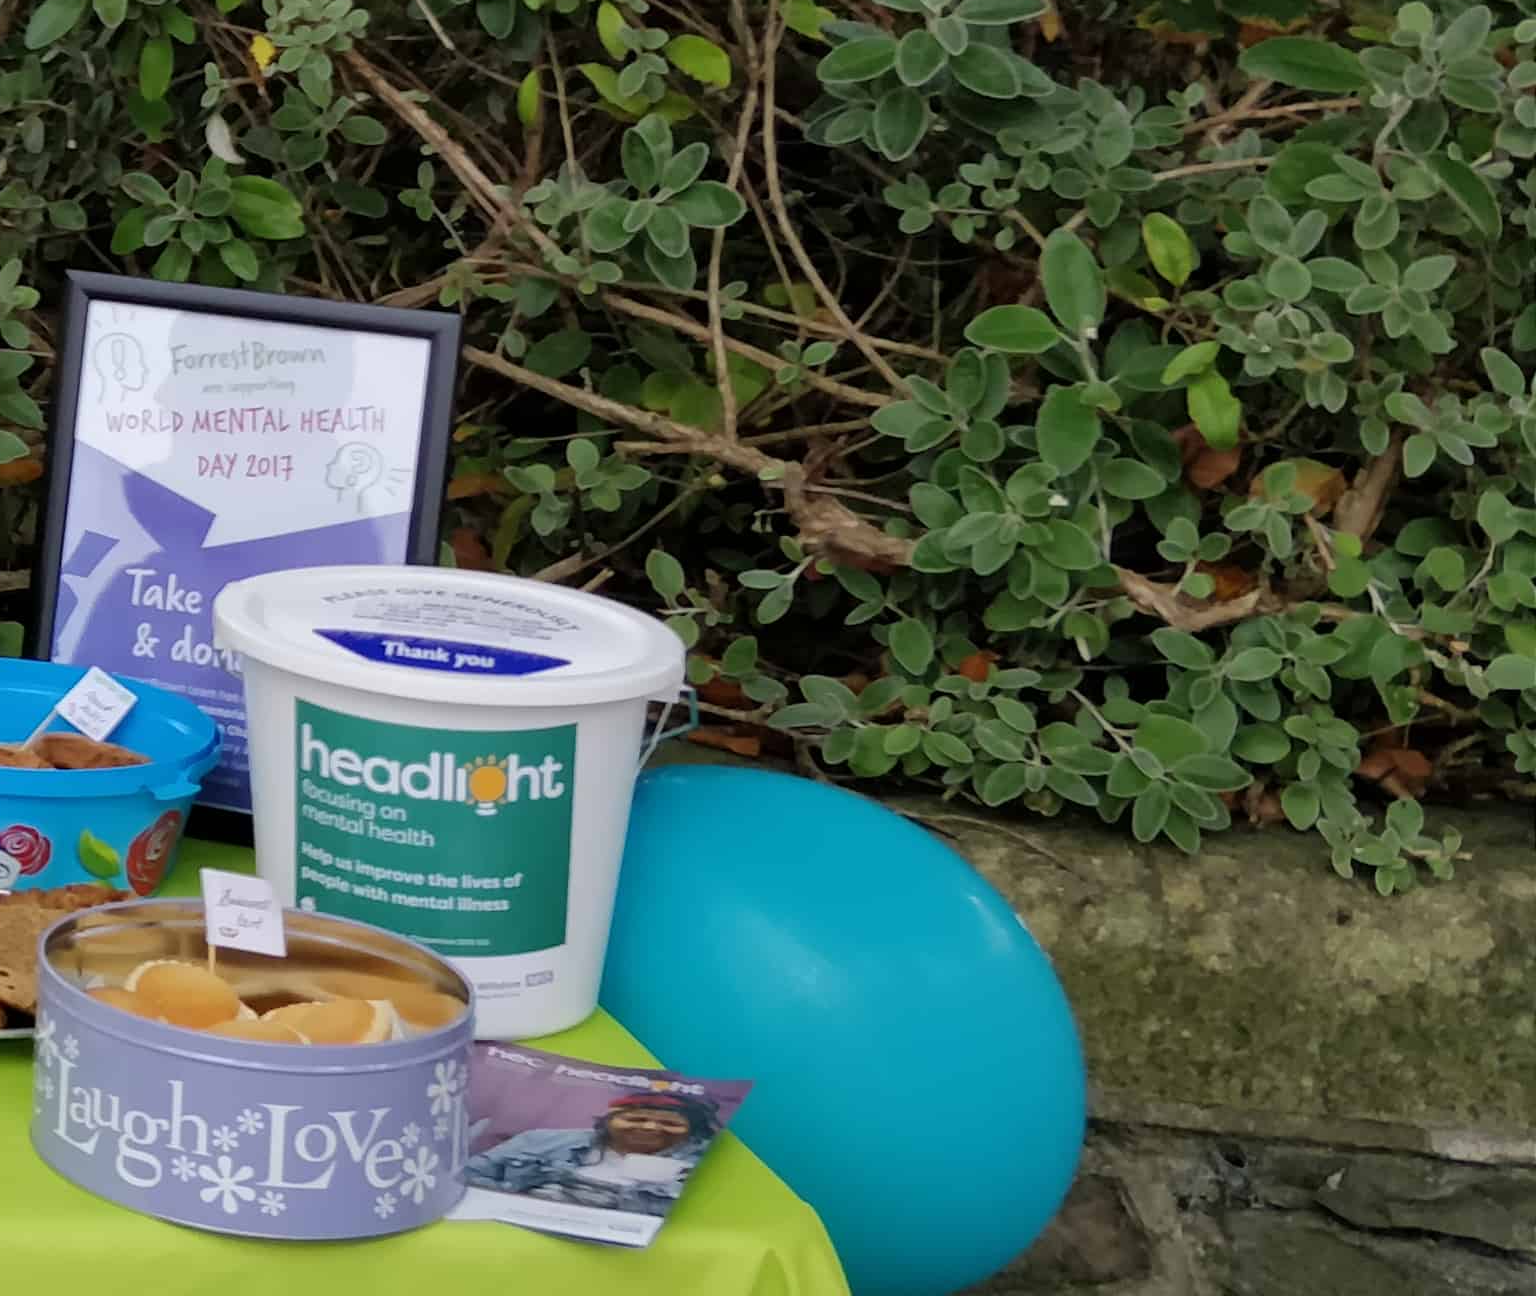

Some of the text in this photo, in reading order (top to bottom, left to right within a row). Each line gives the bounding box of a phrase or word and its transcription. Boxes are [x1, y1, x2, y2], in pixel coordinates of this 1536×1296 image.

[170, 337, 326, 375] ForrestBrown
[106, 406, 385, 434] WORLD MENTAL HEALTH
[197, 453, 295, 480] DAY 2017
[126, 568, 203, 614] Take
[132, 626, 160, 659] &
[381, 640, 495, 669] Thank you
[302, 778, 407, 822] focusing on
[302, 803, 436, 848] mental health
[301, 842, 523, 889] Help us improve the lives of
[351, 880, 390, 903] with
[391, 891, 454, 910] mental
[456, 895, 510, 911] illness
[53, 1055, 210, 1188] Laugh
